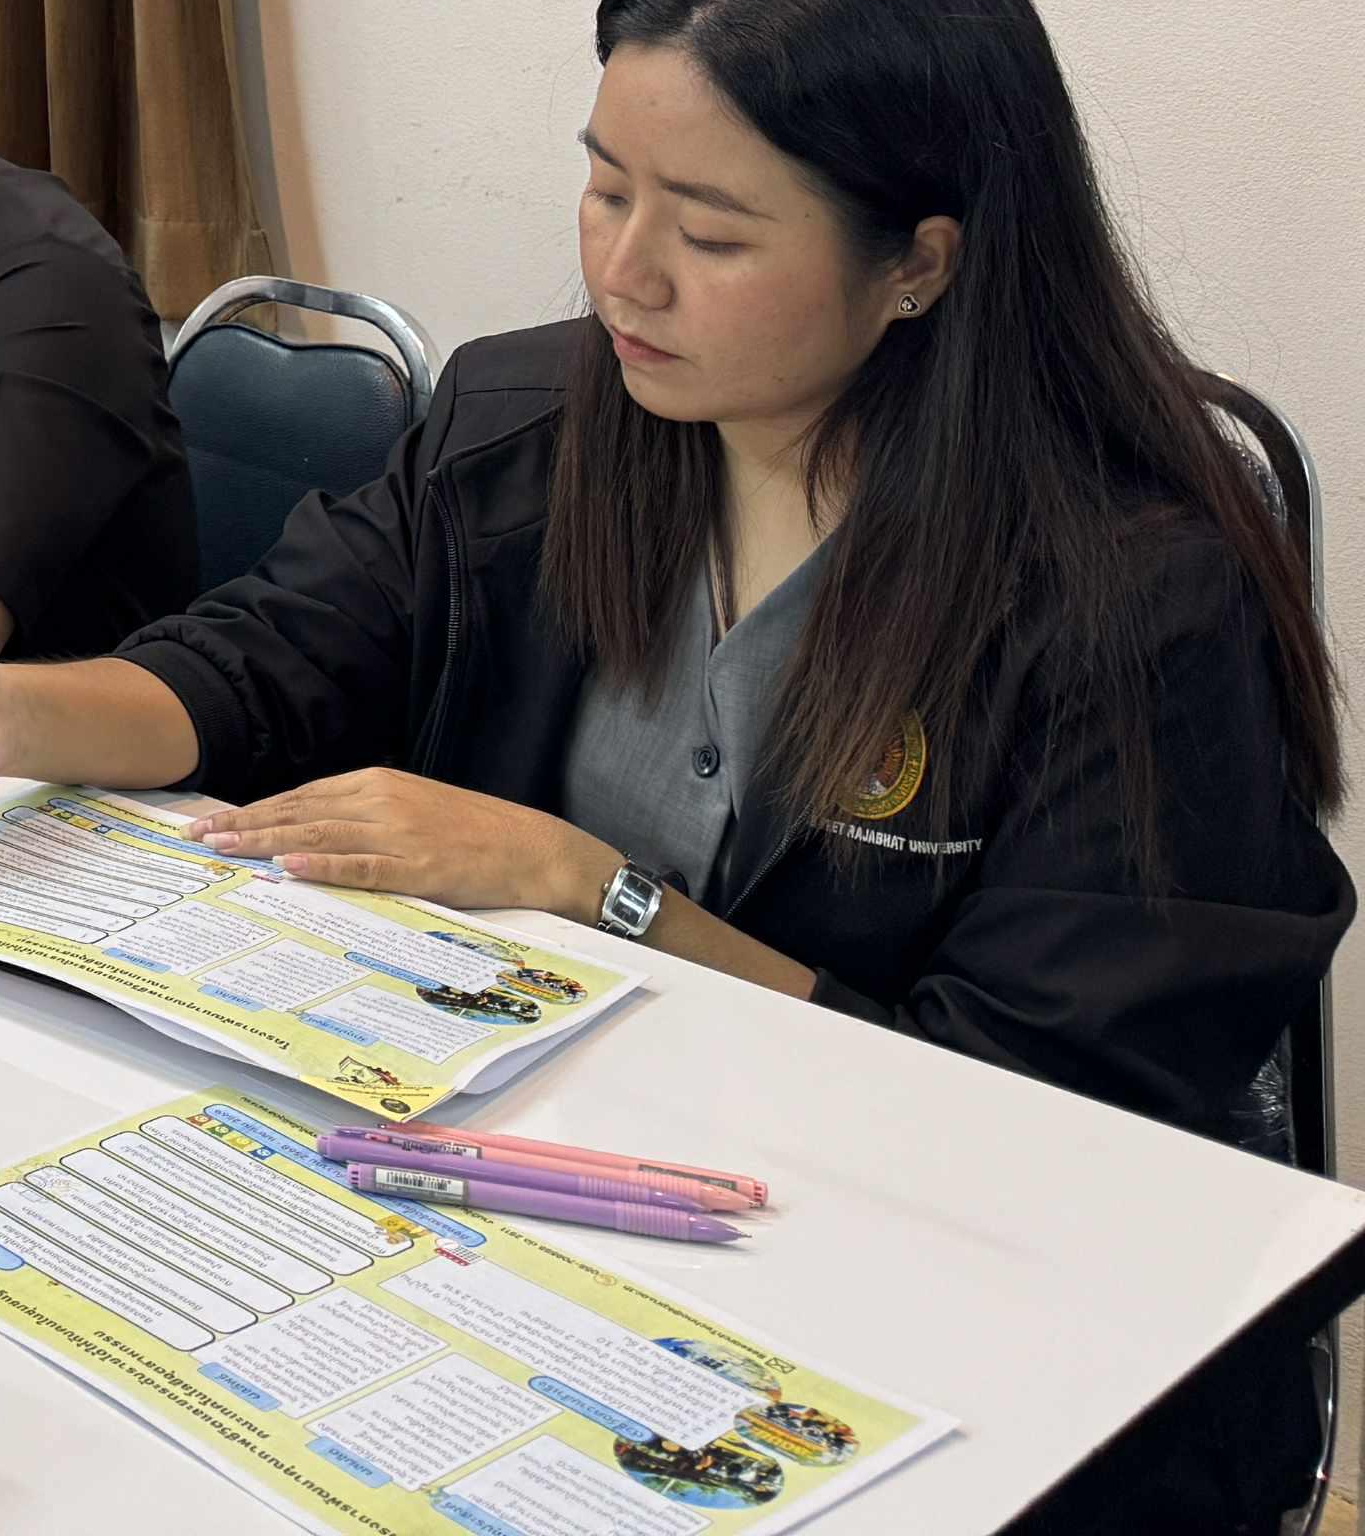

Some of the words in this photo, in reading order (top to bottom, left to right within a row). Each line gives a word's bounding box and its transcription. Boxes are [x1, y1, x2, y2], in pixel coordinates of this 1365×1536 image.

[846, 825, 907, 852] RAJABHAT
[909, 838, 984, 855] UNIVERSITY
[88, 1328, 273, 1443] คณะเทคโนโลยีอุตสาหกรรม
[210, 1371, 265, 1403] ผลลัพธ์
[322, 1445, 377, 1479] ผลผลิต
